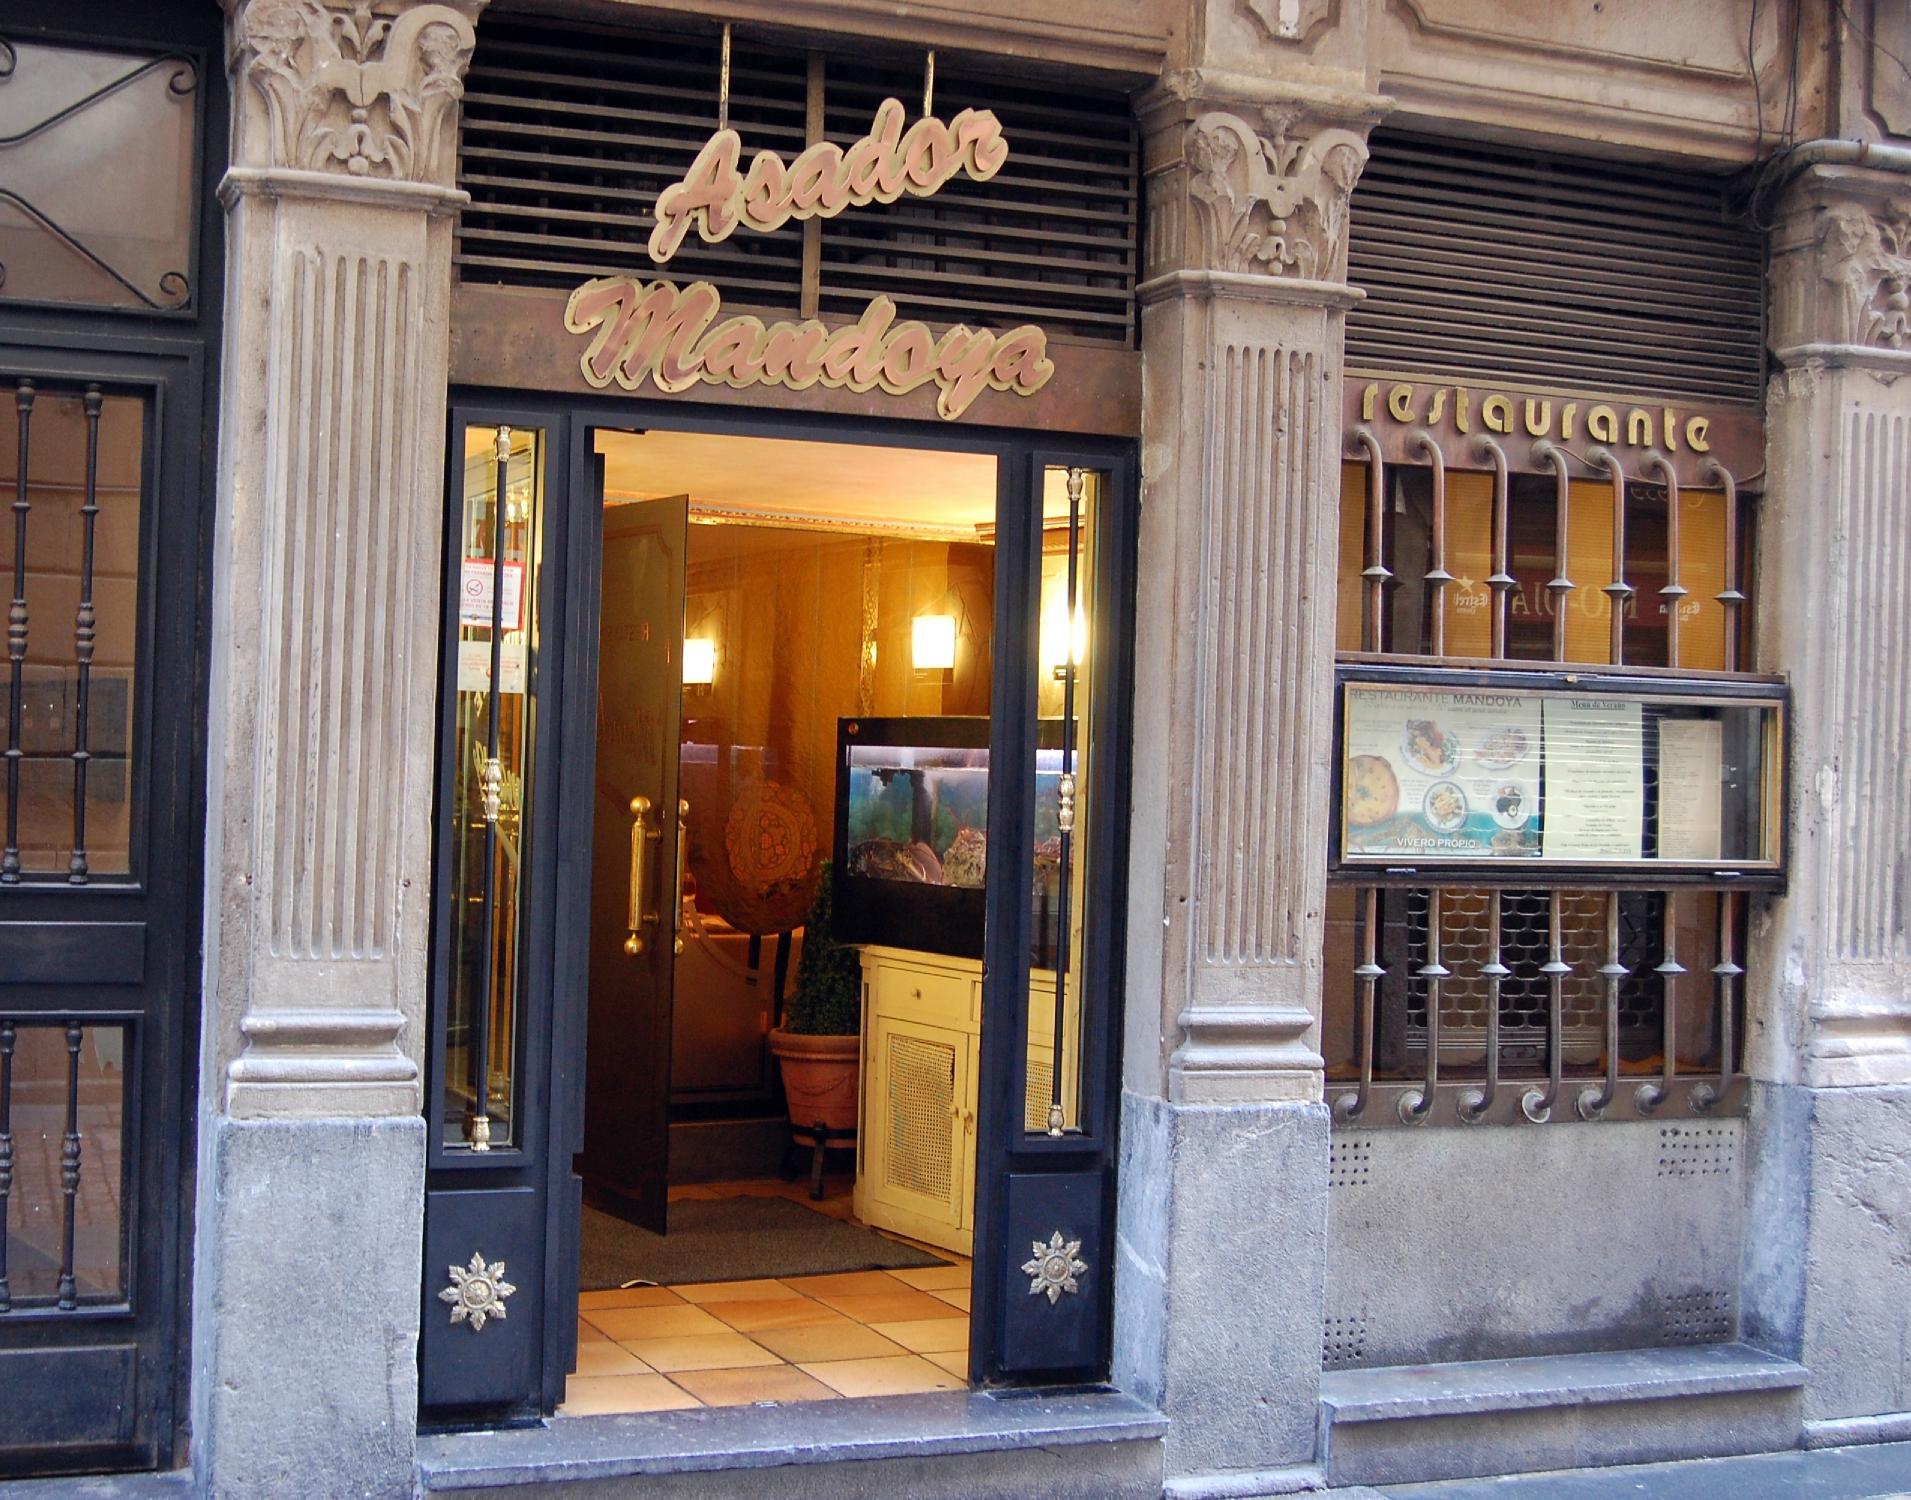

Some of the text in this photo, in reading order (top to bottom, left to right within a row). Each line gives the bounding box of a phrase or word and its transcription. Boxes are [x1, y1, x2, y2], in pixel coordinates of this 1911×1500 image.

[646, 97, 1009, 263] Asador
[564, 275, 1055, 421] Mandoya
[1362, 382, 1711, 453] restaurante
[1350, 688, 1522, 707] RESTAURANTE MANDOYA
[1397, 837, 1476, 848] VIVERO PROPIO
